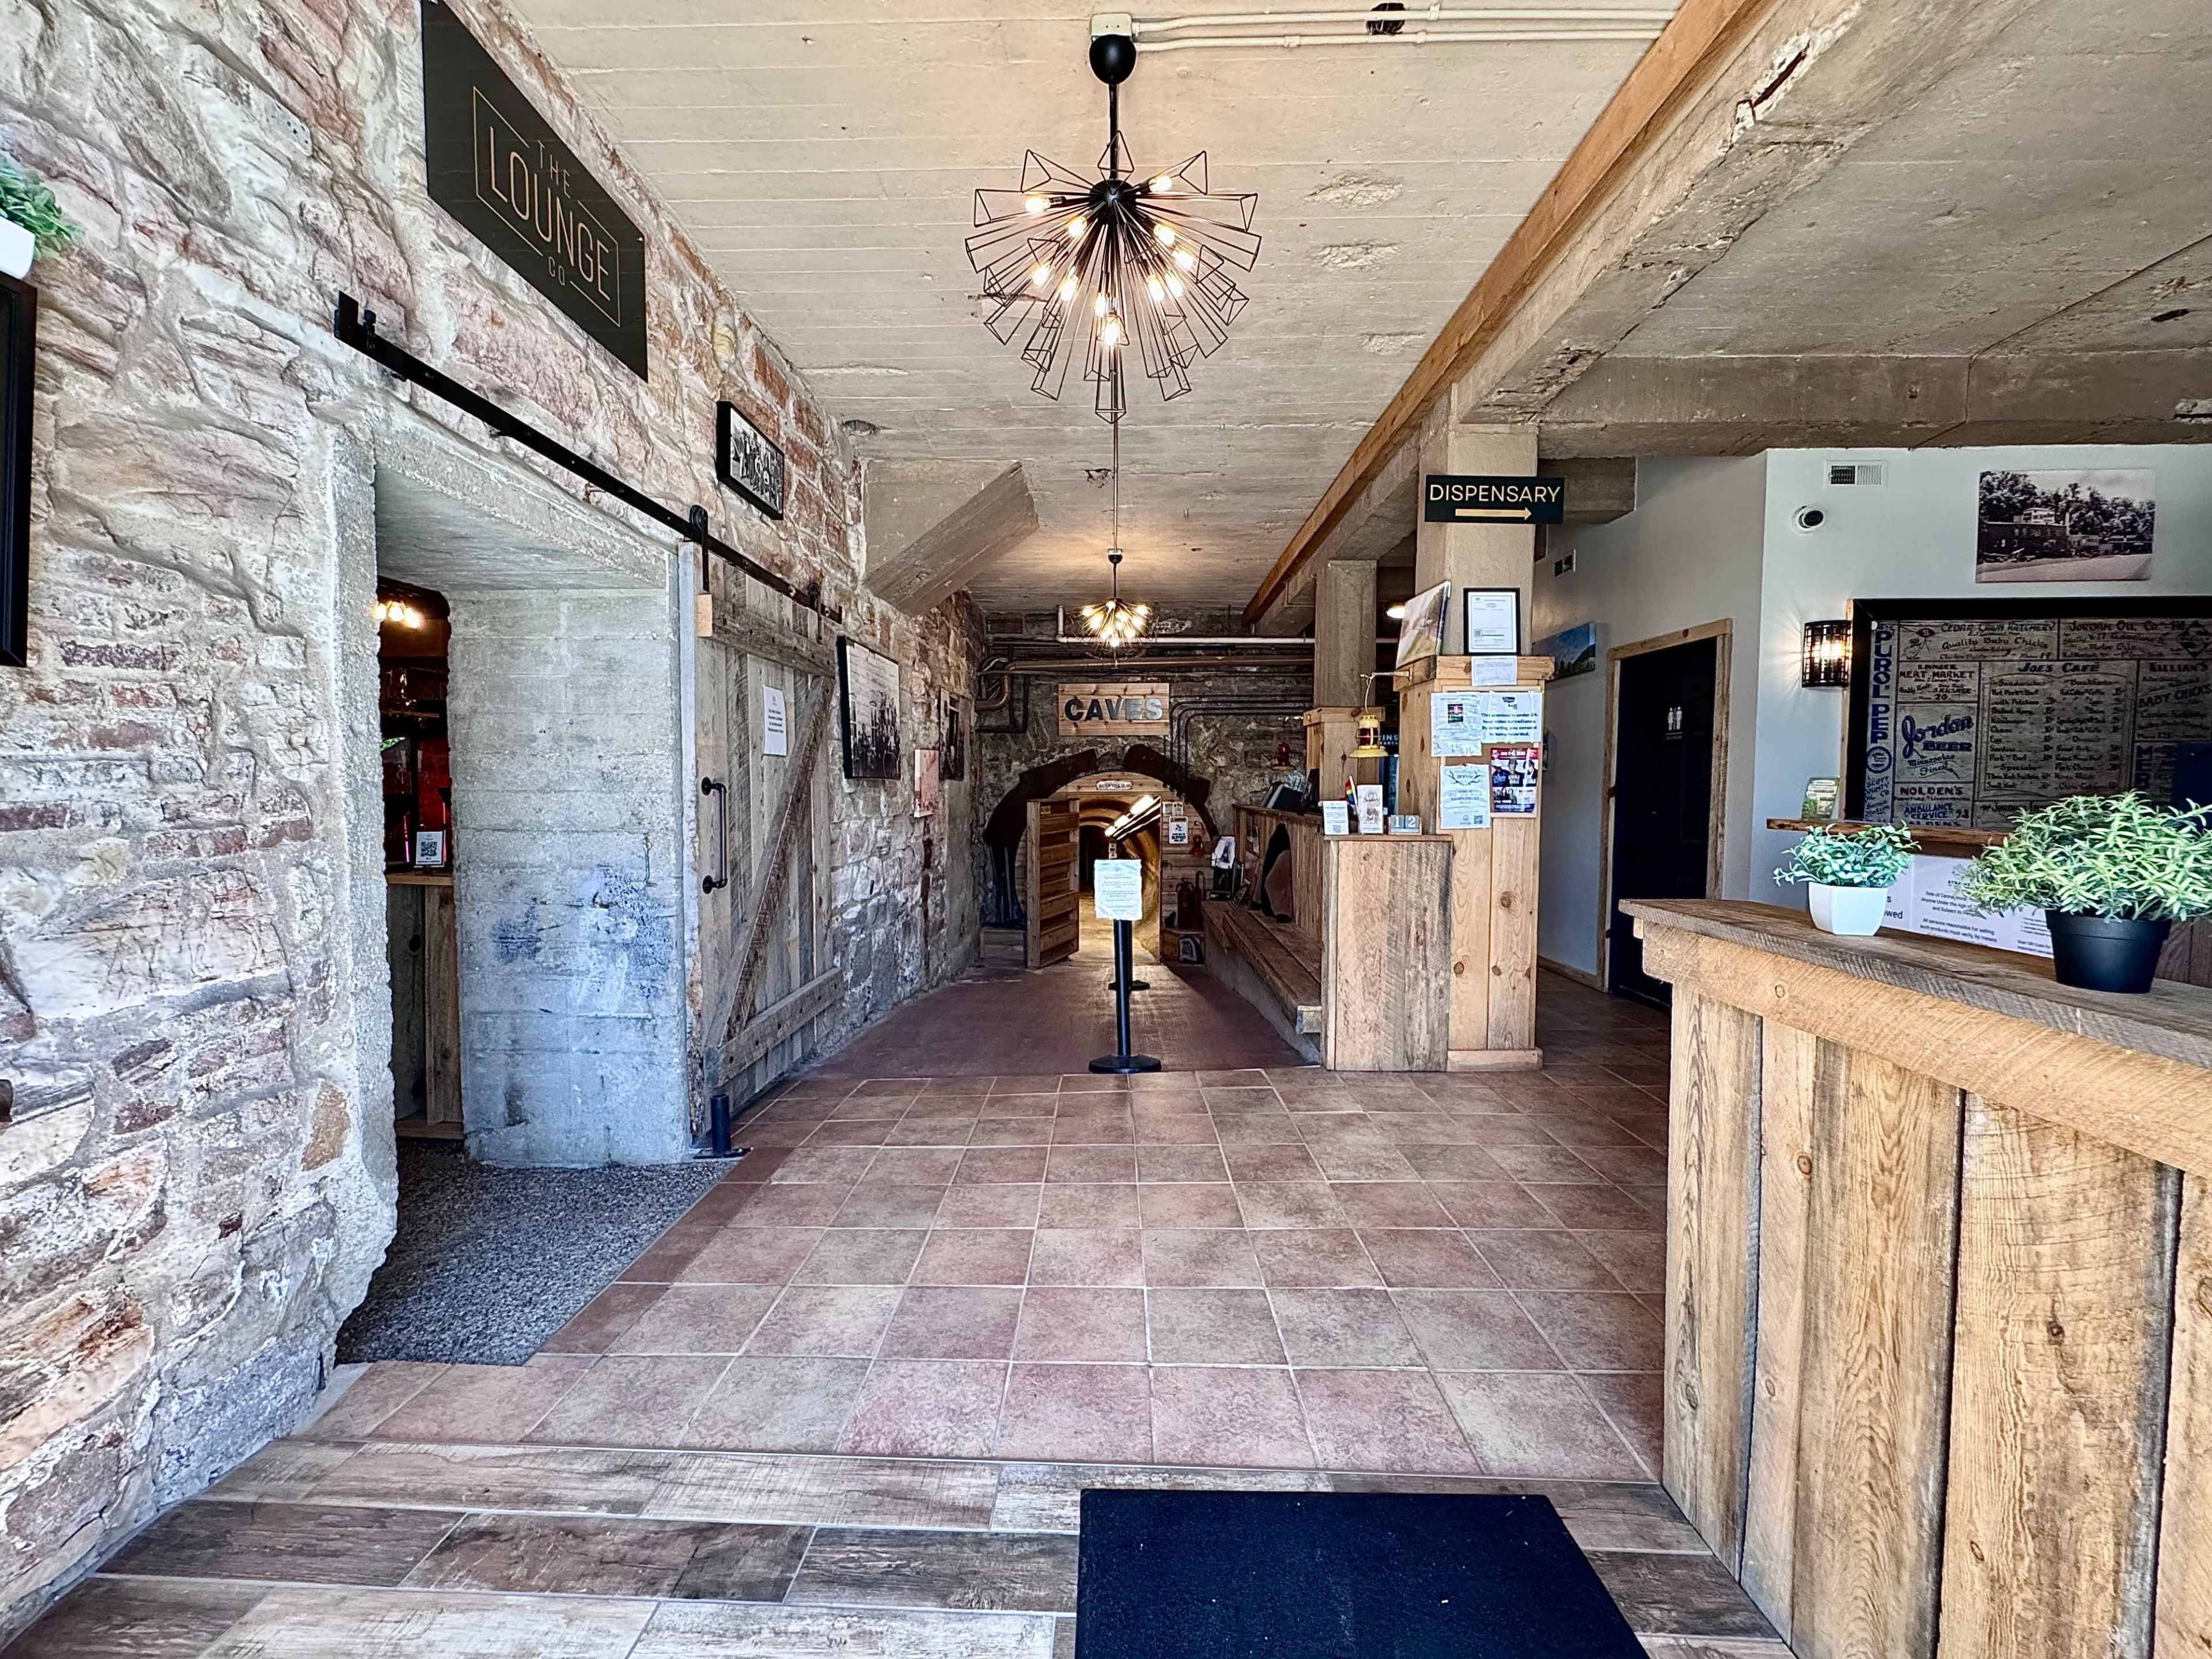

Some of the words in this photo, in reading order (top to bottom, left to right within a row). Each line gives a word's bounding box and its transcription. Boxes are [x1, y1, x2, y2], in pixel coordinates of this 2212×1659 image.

[537, 140, 571, 199] THE
[489, 126, 611, 302] LOUNGE
[548, 257, 566, 286] CO
[1429, 484, 1561, 503] DISPENSARY
[1941, 623, 1974, 632] CEDAR
[1978, 623, 2006, 632] LAWN
[2008, 622, 2056, 632] HATCHERY
[2070, 620, 2113, 631] JORDAN
[2116, 620, 2137, 631] OIL
[1942, 638, 1978, 650] Quality
[1984, 637, 2009, 645] Baby
[2014, 637, 2048, 649] Chicks
[1873, 631, 1893, 699] PUROL
[1064, 698, 1162, 721] CAVES
[1870, 704, 1890, 744] PEP
[1902, 714, 1975, 759] Jordan
[1922, 740, 1972, 752] BEER
[1866, 776, 1889, 788] SCOTT
[1900, 785, 1964, 796] NOLDEN'S
[1904, 802, 1953, 815] AMBULANCE
[1910, 810, 1949, 819] SERVICE
